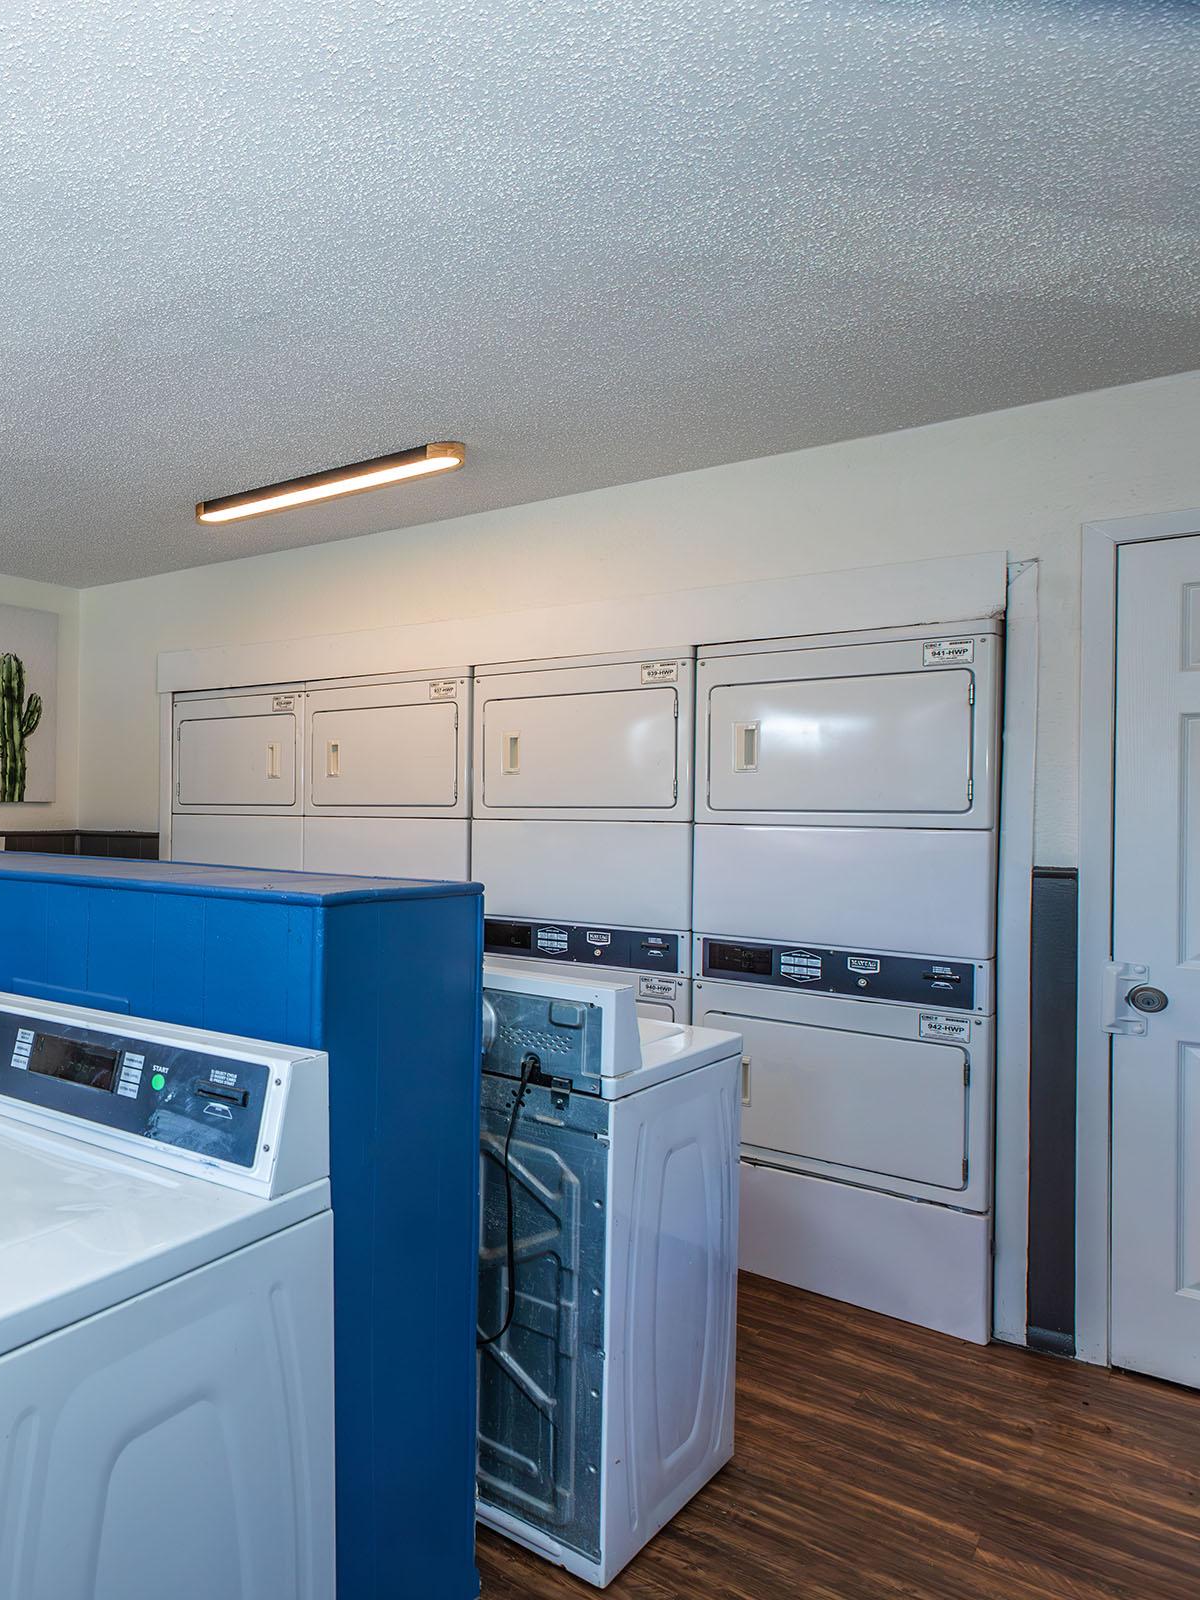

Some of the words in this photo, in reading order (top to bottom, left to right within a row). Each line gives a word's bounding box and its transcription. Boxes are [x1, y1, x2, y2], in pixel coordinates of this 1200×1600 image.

[931, 648, 969, 656] 941-HWP
[851, 959, 877, 968] MAYTAG
[927, 1023, 965, 1032] 942-HWP
[152, 1064, 169, 1074] START
